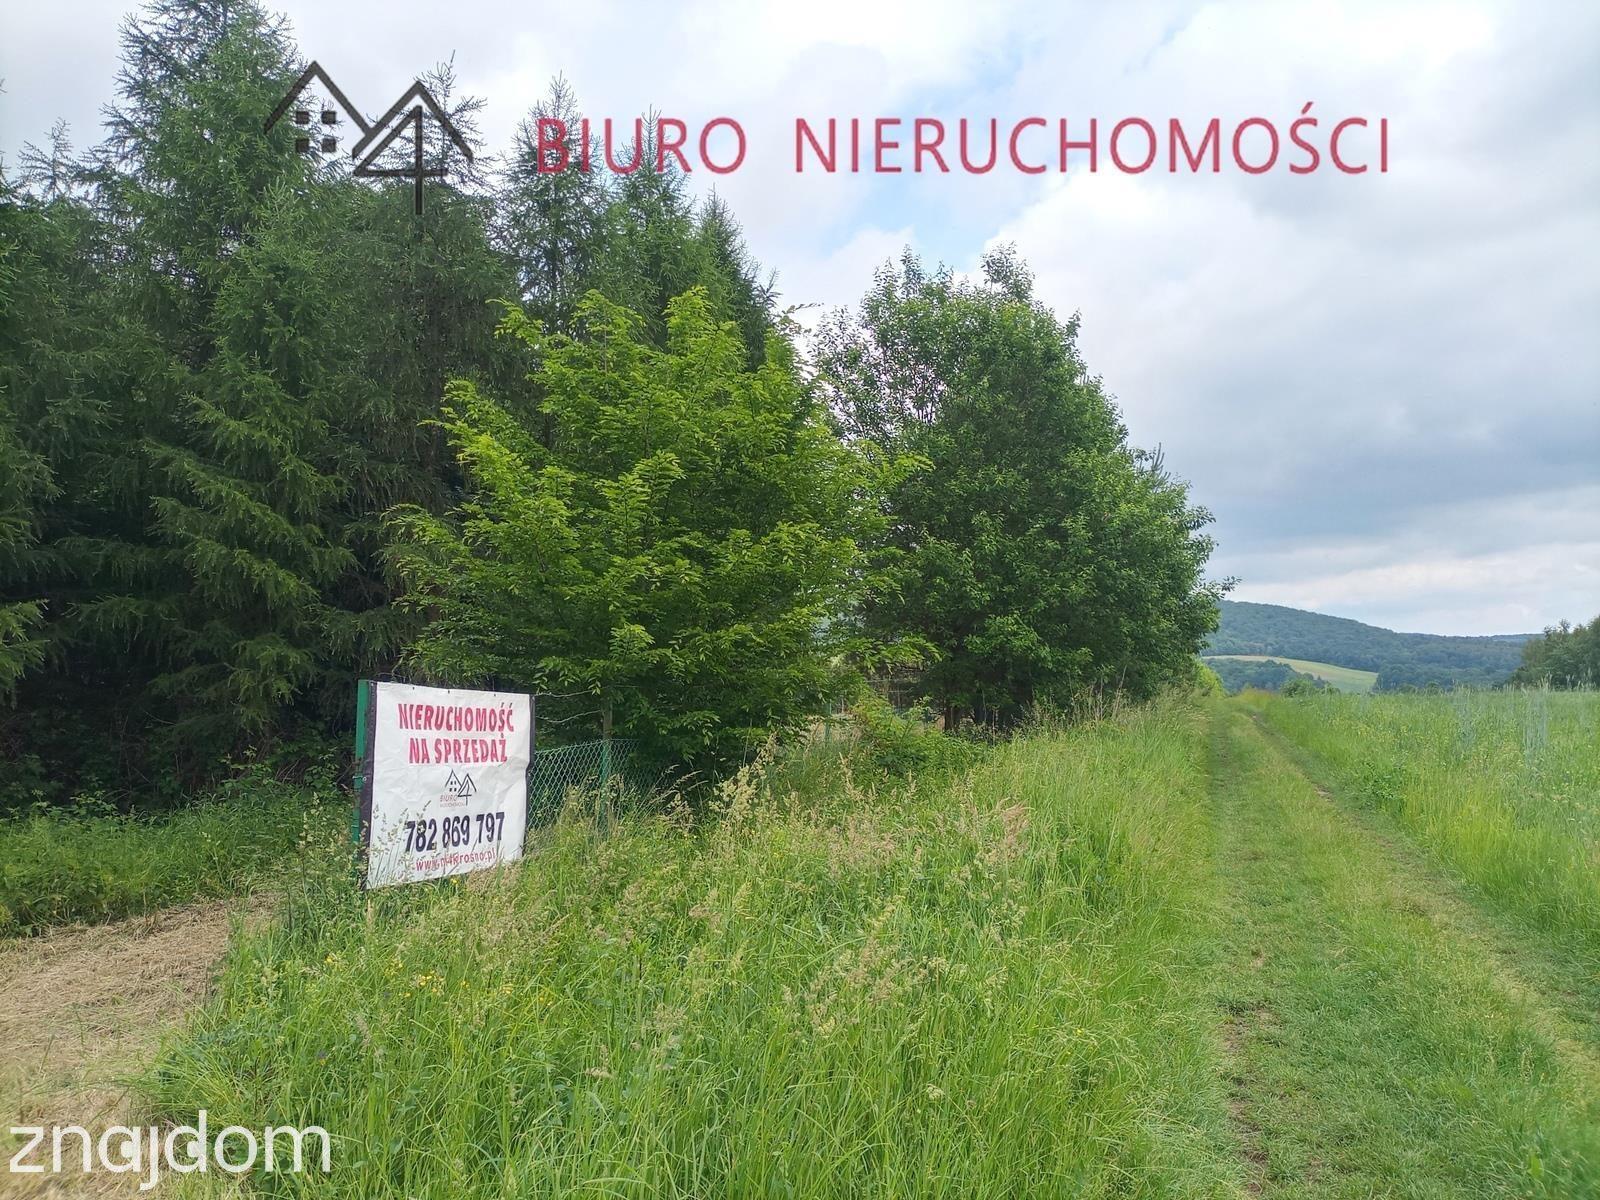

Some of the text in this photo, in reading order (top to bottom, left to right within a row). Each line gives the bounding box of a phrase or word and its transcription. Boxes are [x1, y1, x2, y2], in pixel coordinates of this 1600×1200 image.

[398, 702, 514, 732] NIERUCHOMOŚĆ
[409, 733, 508, 764] NA SPRZEDAŻ
[405, 812, 505, 852] 782 869 797
